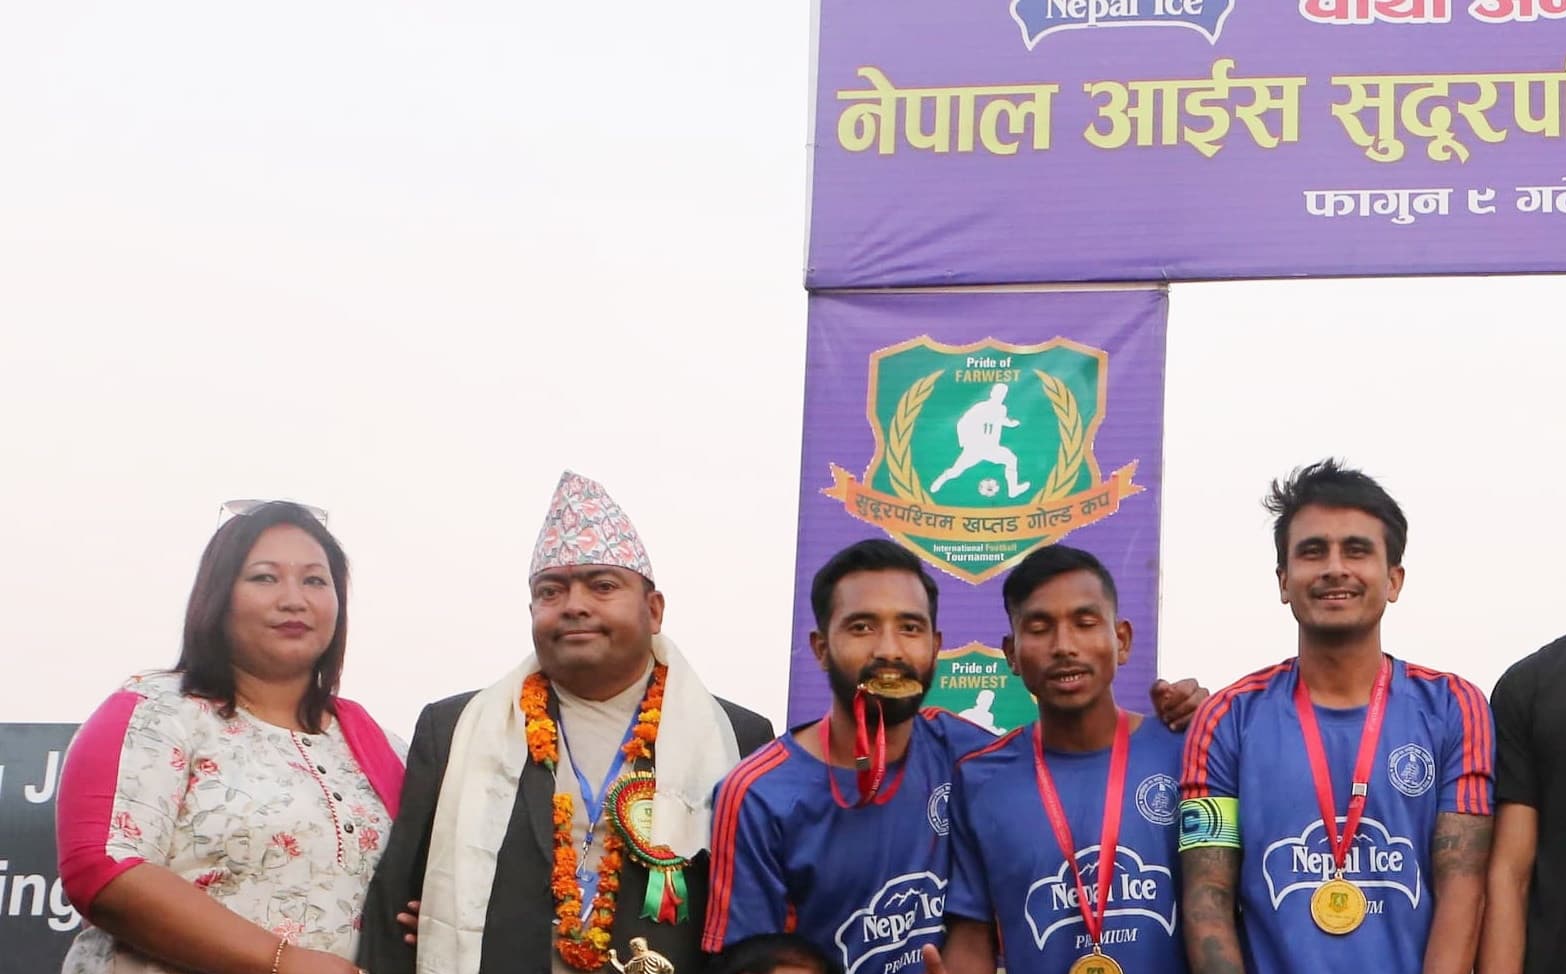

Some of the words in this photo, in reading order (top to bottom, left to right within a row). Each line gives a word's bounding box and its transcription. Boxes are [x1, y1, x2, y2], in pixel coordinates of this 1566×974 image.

[836, 66, 1060, 155] नेपाल
[1082, 58, 1307, 158] आईस
[1303, 188, 1453, 225] फागुन
[966, 356, 997, 369] Pride
[999, 356, 1012, 369] of
[955, 369, 1020, 383] FARWEST
[933, 543, 984, 553] International
[945, 552, 1005, 562] Tournament
[952, 662, 982, 674] Pride
[985, 662, 998, 674] of
[940, 675, 1009, 689] FARWEST
[1369, 846, 1403, 873] Ice
[1120, 874, 1156, 900] Ice
